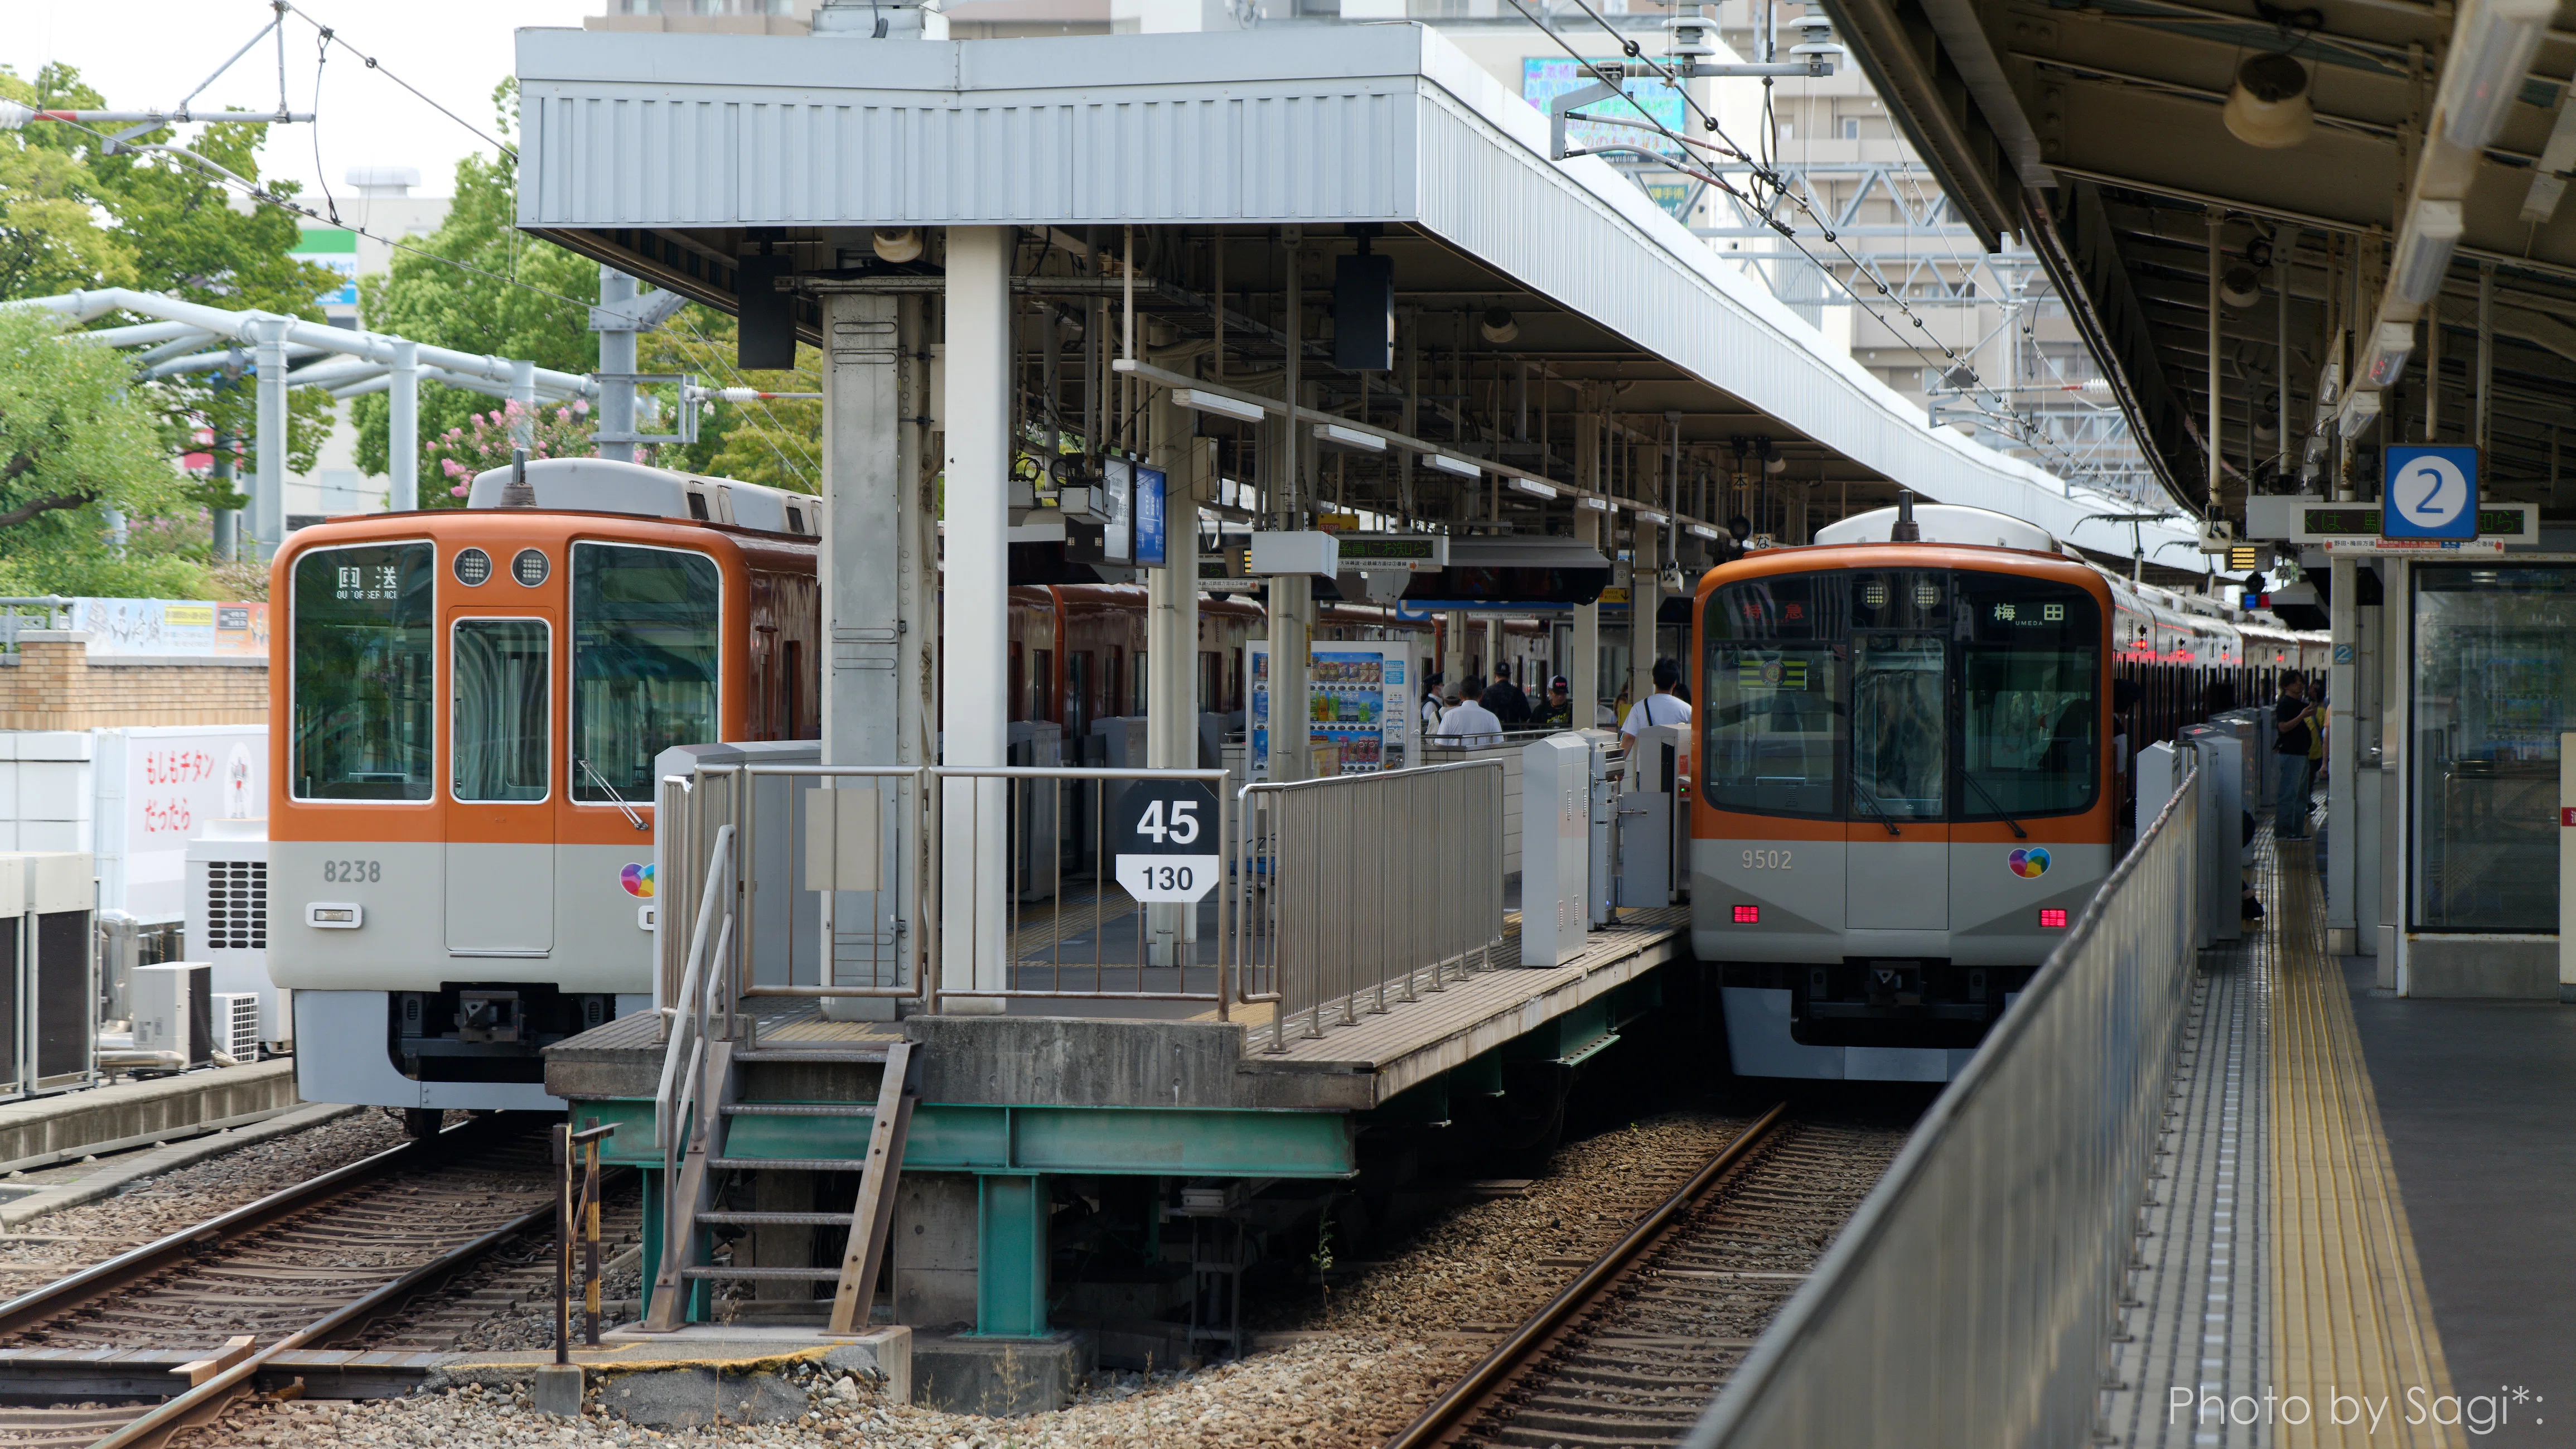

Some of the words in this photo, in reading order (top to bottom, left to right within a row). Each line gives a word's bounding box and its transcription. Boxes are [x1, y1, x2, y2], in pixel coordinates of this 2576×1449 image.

[1734, 475, 1747, 488] 本
[2415, 468, 2444, 513] 2
[1757, 535, 1770, 549] な
[1743, 603, 1804, 619] 特急
[1994, 603, 2064, 621] 梅田
[2338, 645, 2349, 660] 2
[146, 749, 215, 785] もしもチタン
[144, 796, 191, 832] だったら
[1137, 800, 1199, 844] 45
[1742, 849, 1791, 870] 9502
[324, 860, 380, 882] 8238
[1142, 866, 1193, 891] 130
